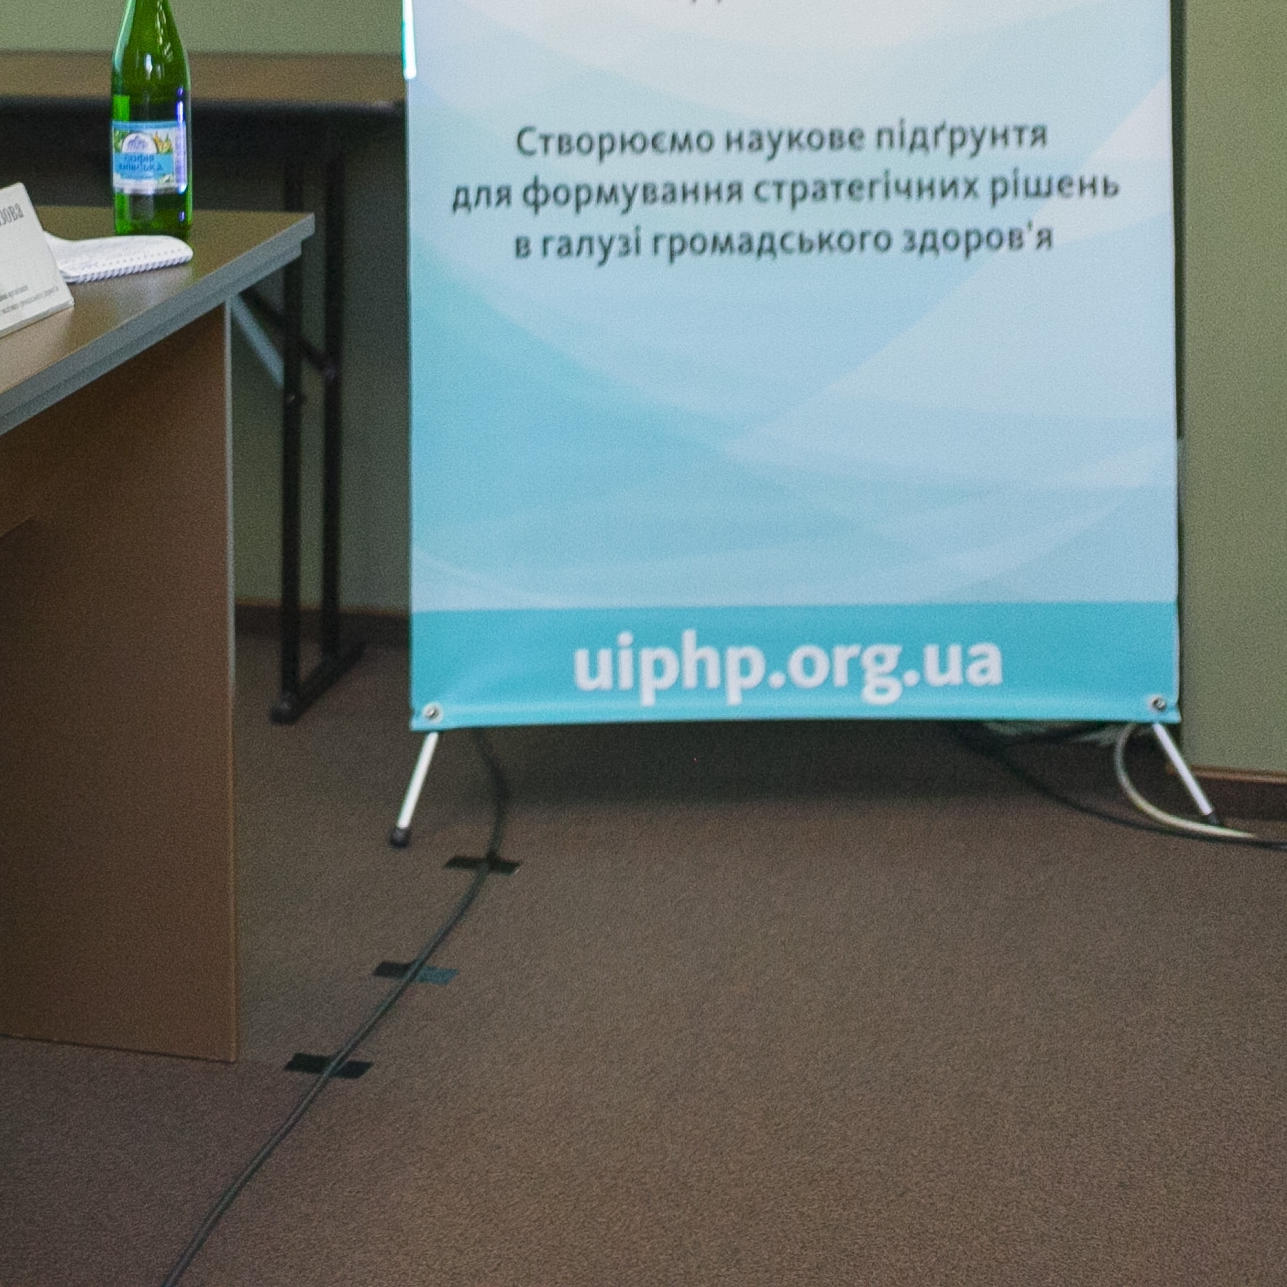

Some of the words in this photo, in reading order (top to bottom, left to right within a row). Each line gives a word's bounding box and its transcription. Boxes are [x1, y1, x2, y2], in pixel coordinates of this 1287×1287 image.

[515, 125, 717, 164] Створюємо
[725, 125, 866, 160] наукове
[875, 118, 1049, 155] підґрунтя
[452, 181, 513, 214] для
[521, 174, 744, 214] формування
[753, 168, 980, 210] стратегічних
[989, 169, 1121, 207] рішень
[515, 237, 532, 259] в
[541, 224, 644, 268] галузі
[651, 223, 893, 265] громадського
[902, 219, 1055, 260] здоров'я
[574, 627, 1005, 708] uiphp.org.ua
